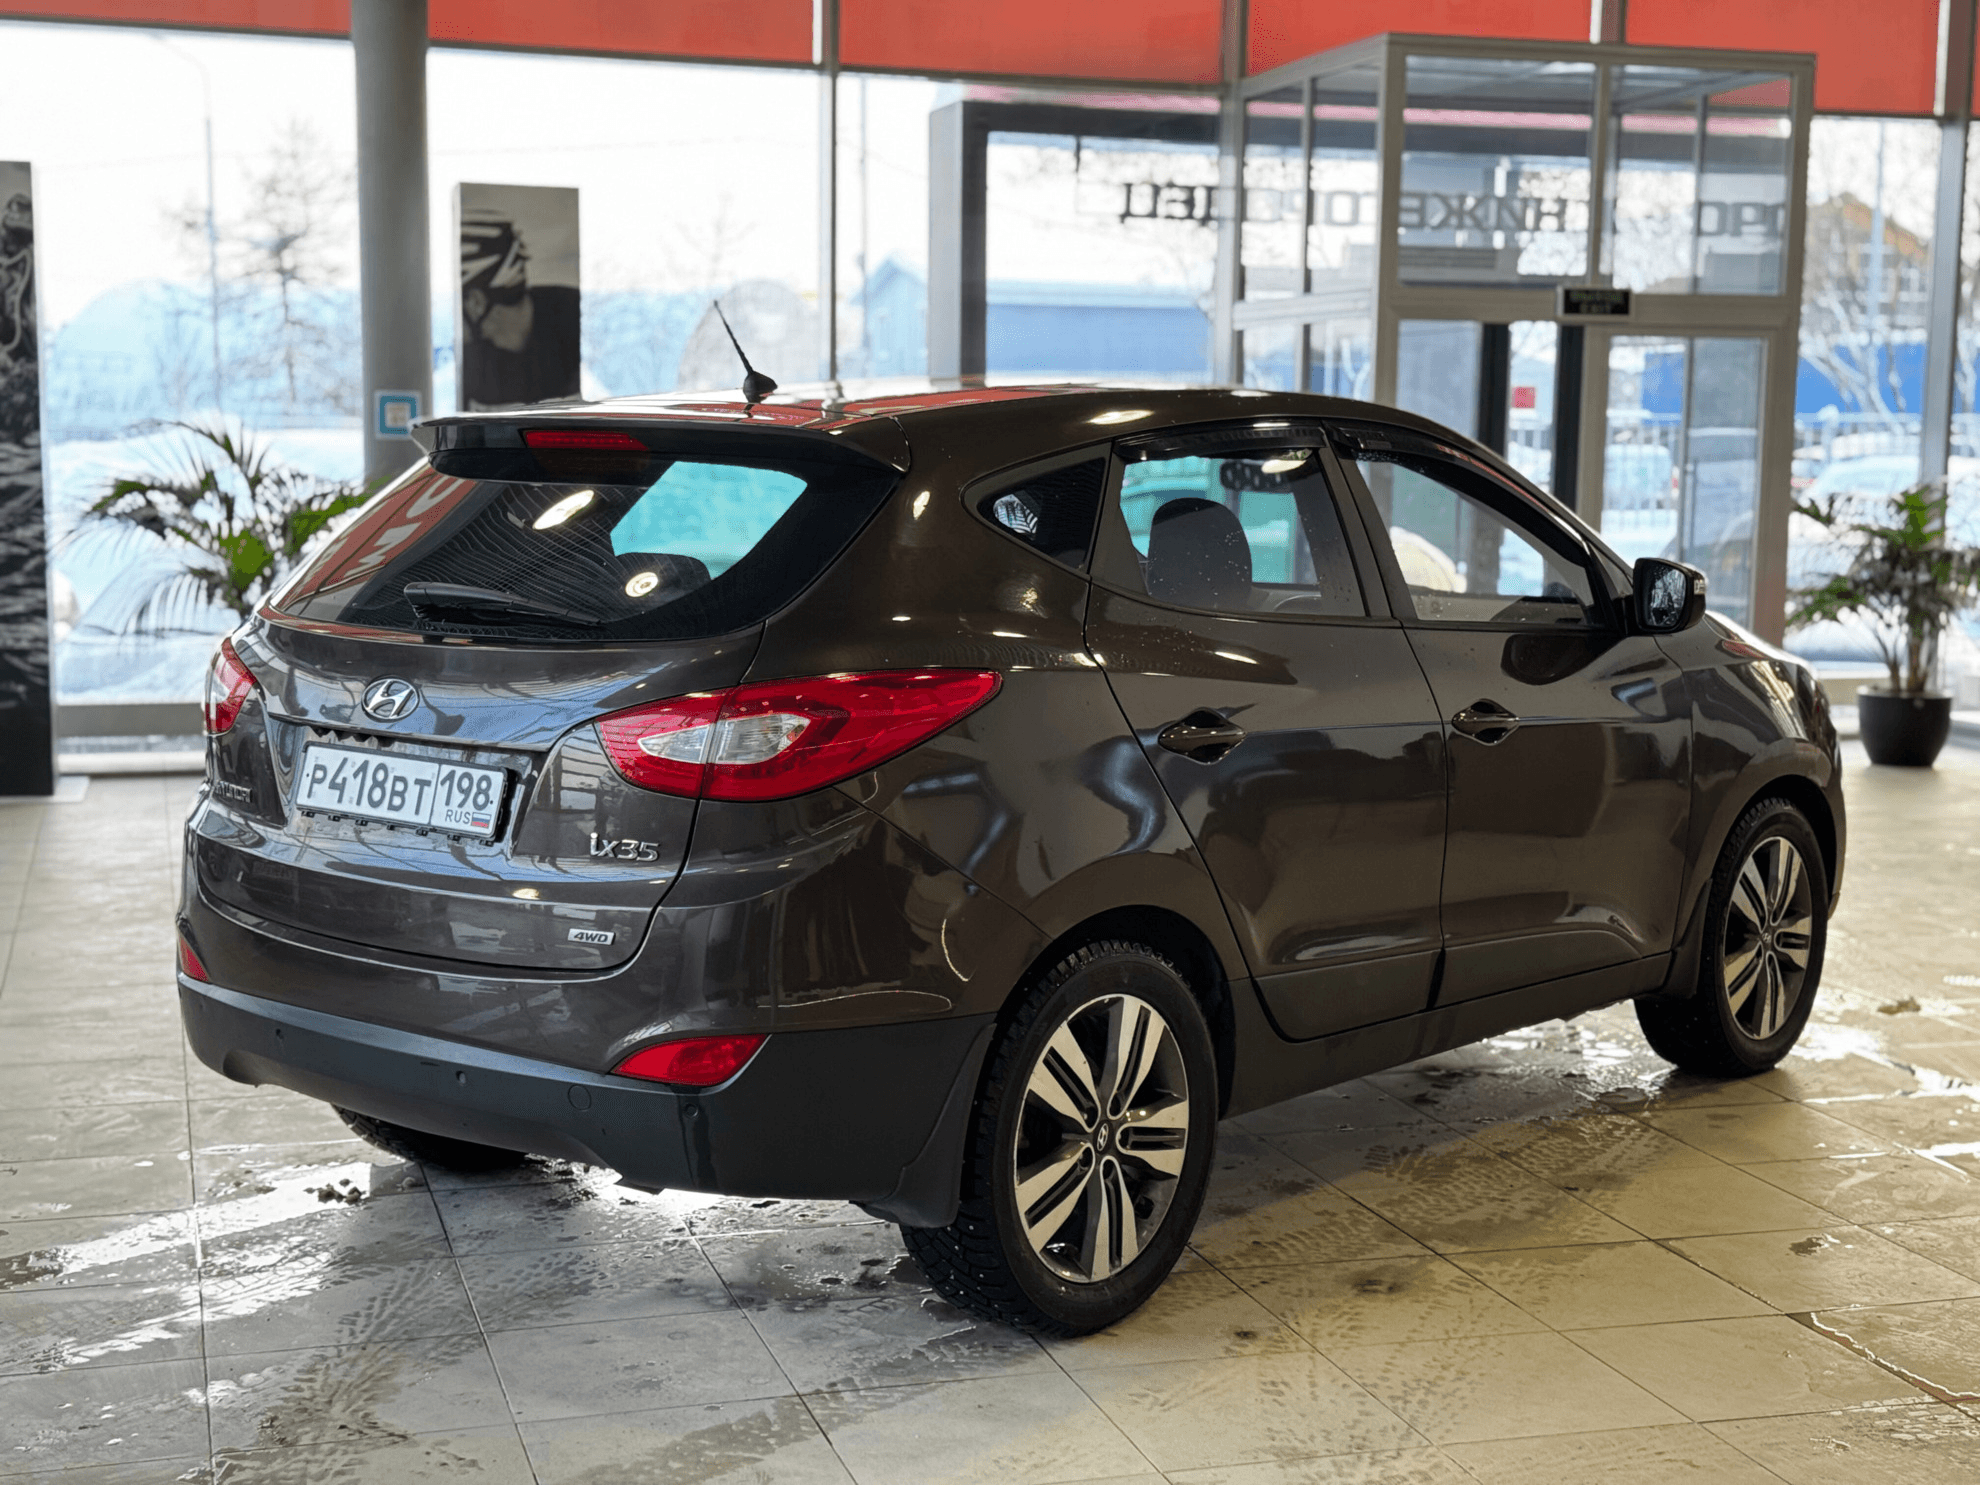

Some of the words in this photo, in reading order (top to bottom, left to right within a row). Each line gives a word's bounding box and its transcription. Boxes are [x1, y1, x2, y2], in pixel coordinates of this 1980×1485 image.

[306, 756, 432, 816] Р418ВТ
[440, 769, 492, 811] 198
[445, 809, 471, 825] RUS
[573, 931, 609, 944] 4WD
